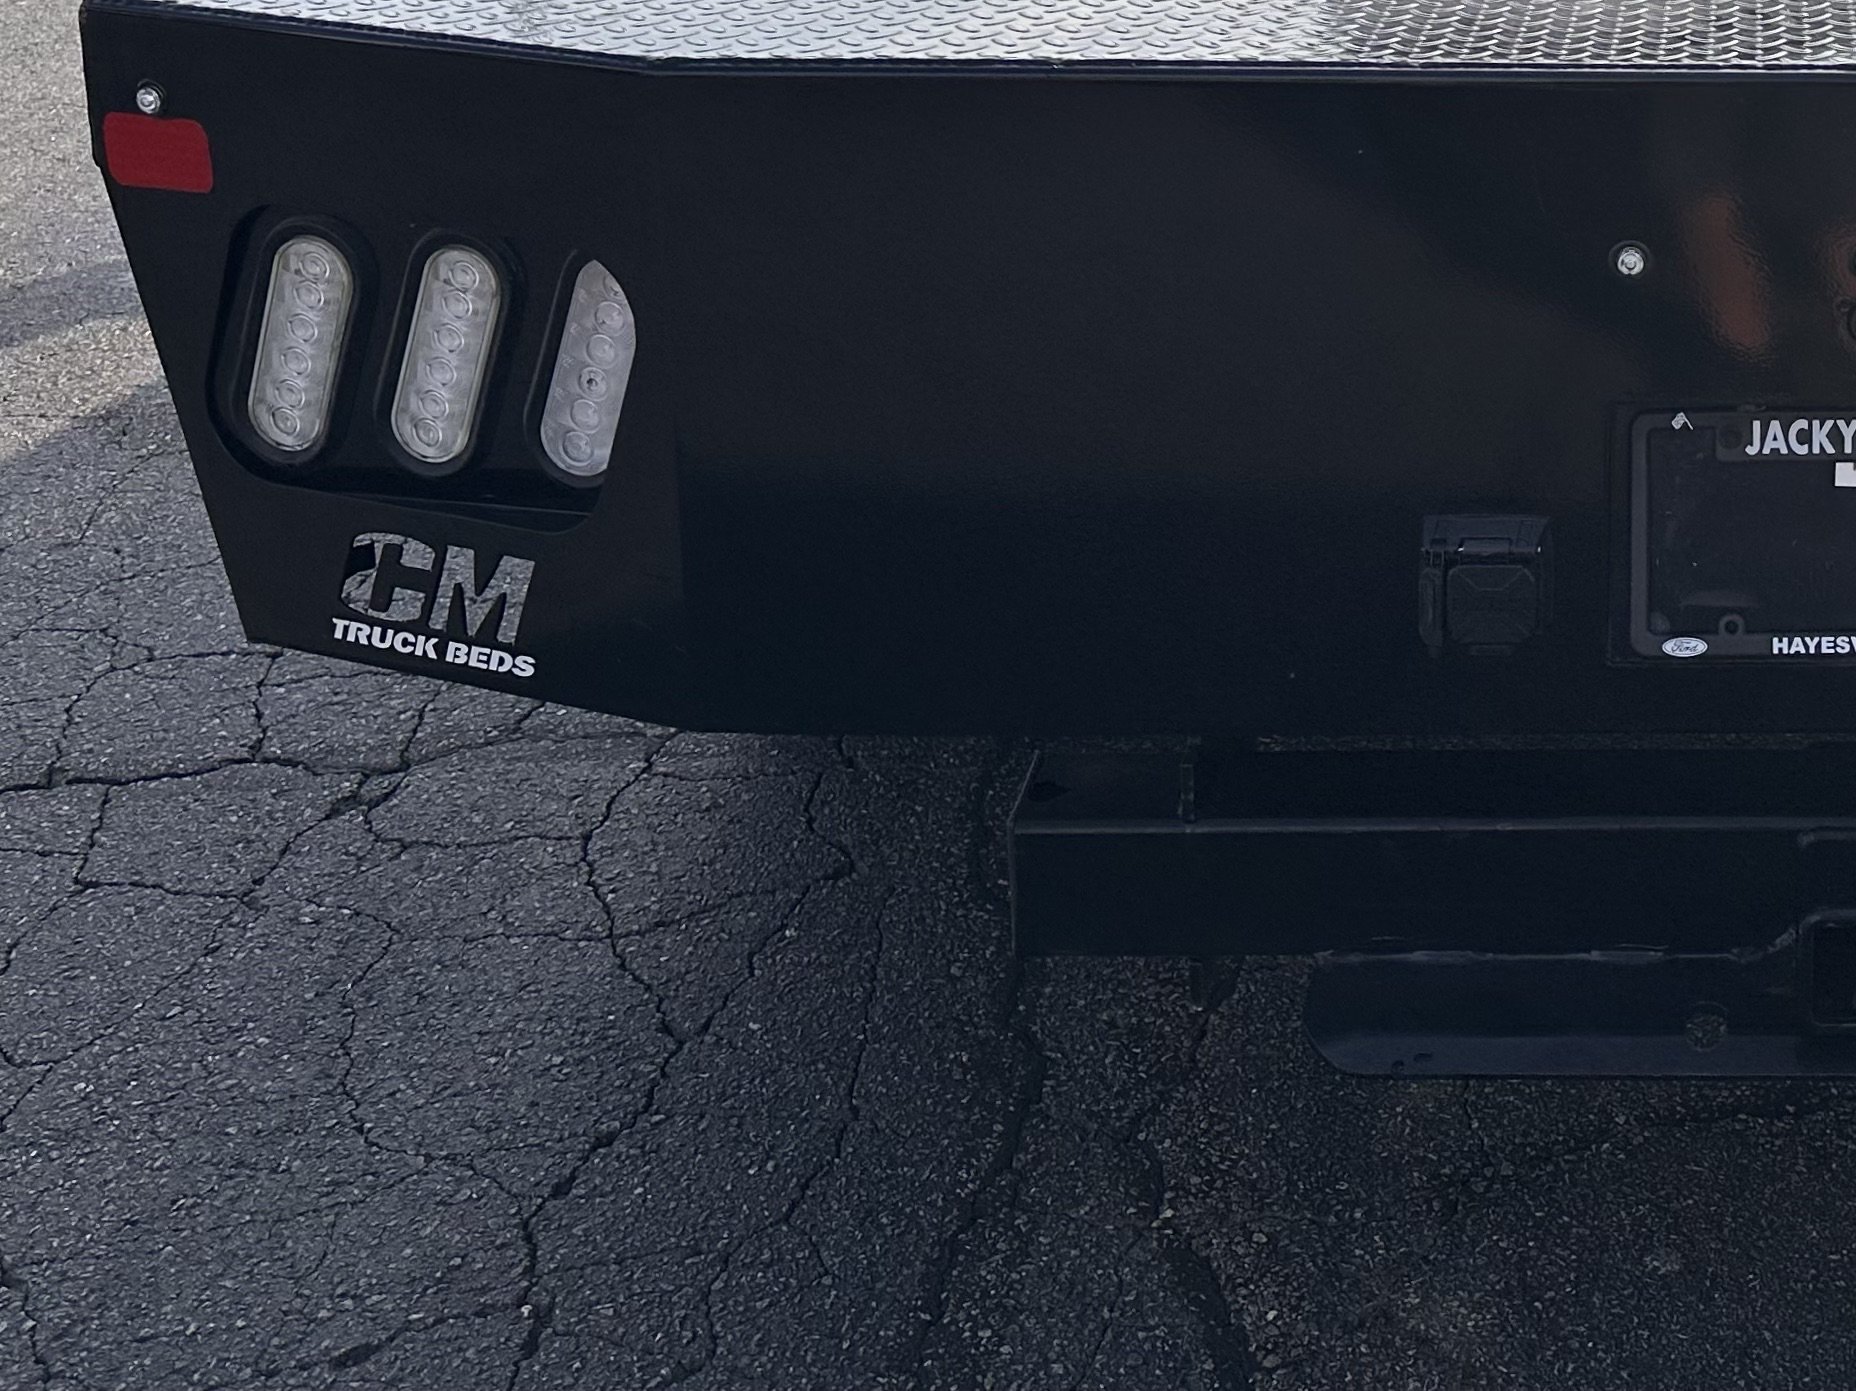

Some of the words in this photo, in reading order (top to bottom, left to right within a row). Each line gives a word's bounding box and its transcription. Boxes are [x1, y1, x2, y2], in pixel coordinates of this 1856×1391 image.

[340, 531, 536, 646] CM
[331, 617, 440, 660] TRUCK
[445, 640, 536, 677] BEDS
[1671, 639, 1699, 654] Ford
